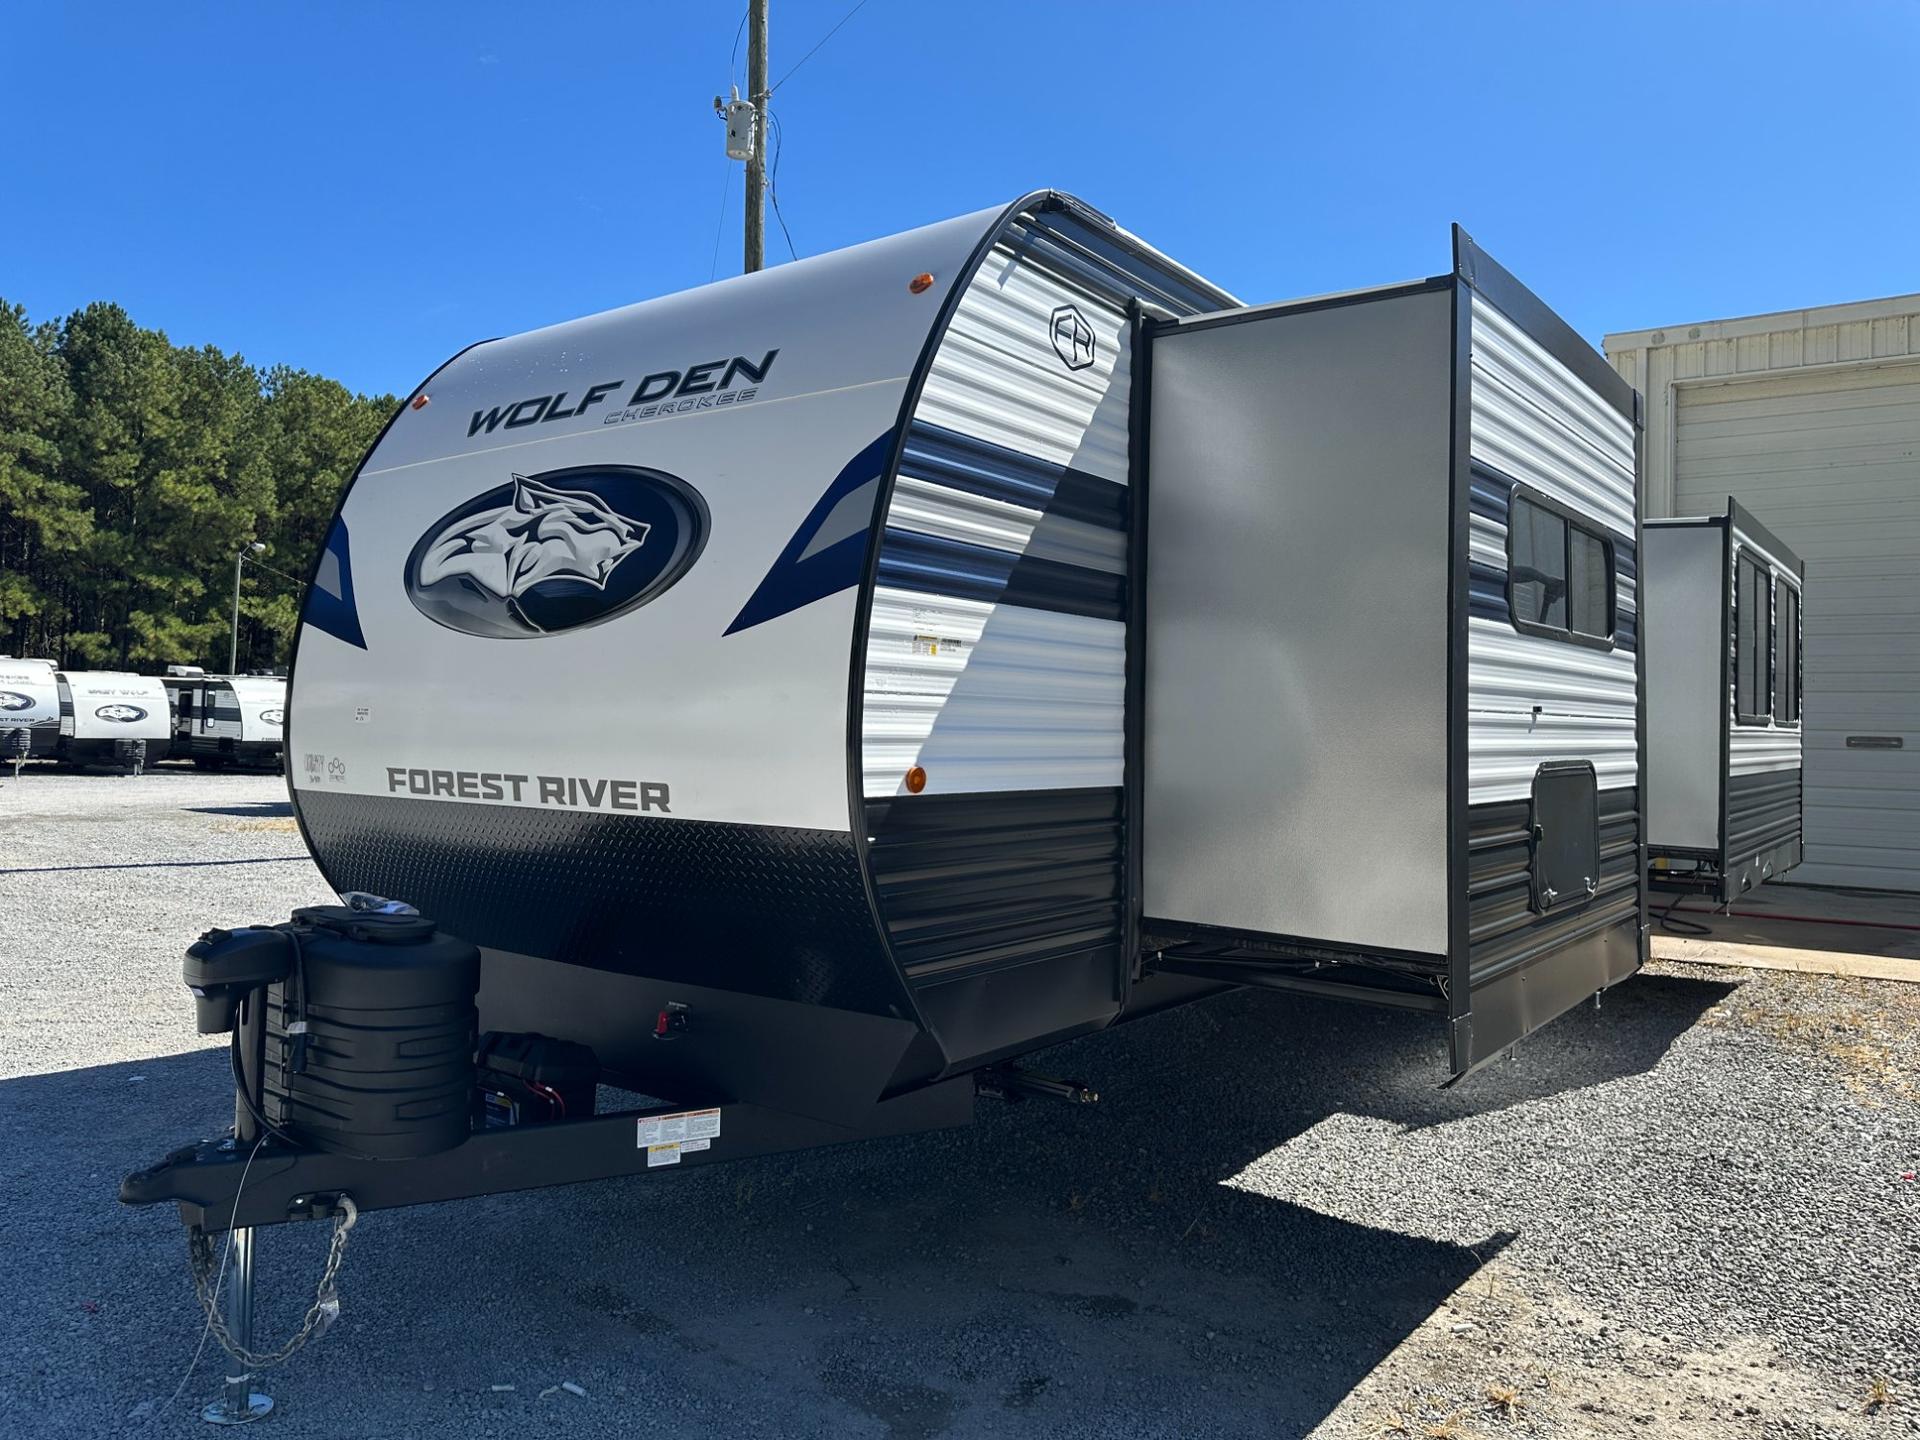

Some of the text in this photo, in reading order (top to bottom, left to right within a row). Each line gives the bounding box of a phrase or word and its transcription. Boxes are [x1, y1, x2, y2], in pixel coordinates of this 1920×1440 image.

[467, 348, 780, 438] WOLF DEN
[603, 387, 759, 424] CHEROKEE
[386, 767, 672, 813] FOREST RIVER
